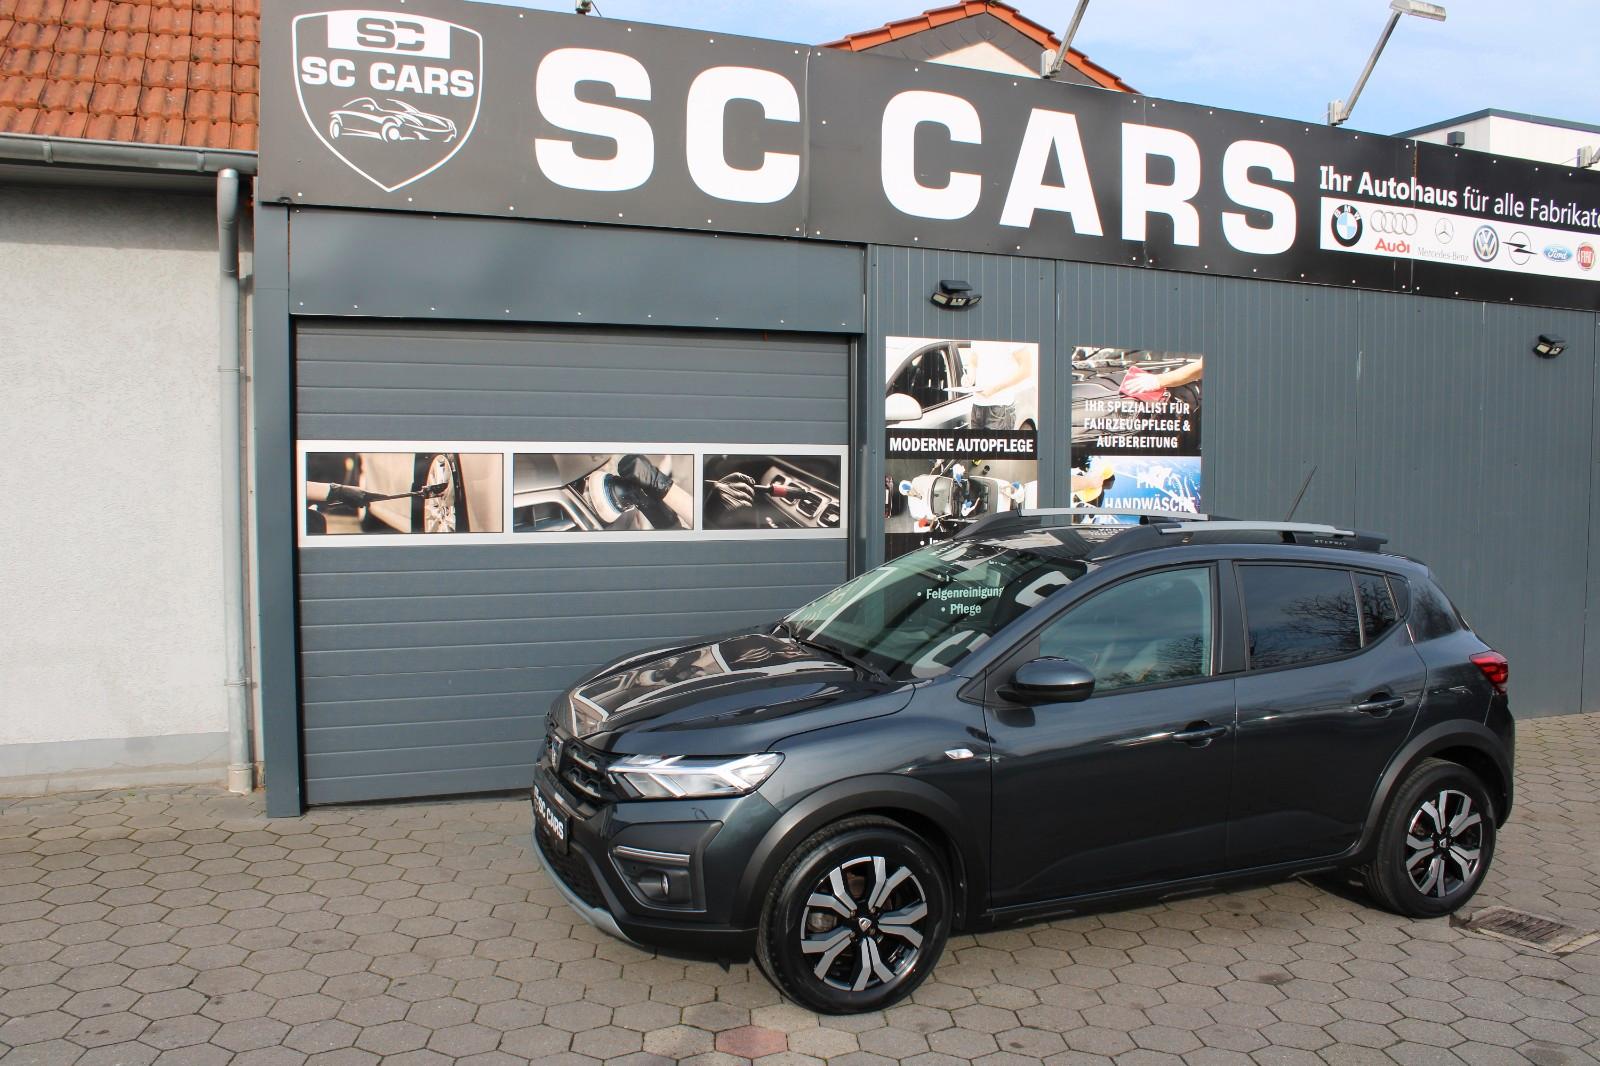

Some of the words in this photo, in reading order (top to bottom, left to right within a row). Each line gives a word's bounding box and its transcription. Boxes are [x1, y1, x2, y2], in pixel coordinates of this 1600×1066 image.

[357, 17, 425, 51] SC
[301, 56, 355, 87] SC
[369, 62, 475, 97] CARS
[535, 48, 801, 204] SC
[881, 89, 1297, 255] CARS
[1319, 165, 1353, 193] Ihr
[1357, 171, 1458, 208] Autohaus
[1463, 186, 1490, 212] für
[1493, 192, 1525, 218] alle
[1375, 238, 1410, 253] Audi
[1085, 400, 1104, 412] IHR
[1107, 401, 1167, 414] SPEZIALIST
[1169, 400, 1190, 415] FÜR
[1085, 418, 1180, 431] FAHRZEUGPFLEGE
[1182, 420, 1191, 432] &
[889, 437, 954, 452] MODERNE
[956, 438, 1034, 453] AUTOPFLEGE
[1096, 436, 1178, 448] AUFBEREITUNG
[926, 586, 1005, 601] Felgenreinigung
[950, 603, 982, 616] Pflege
[546, 807, 564, 840] CARS
